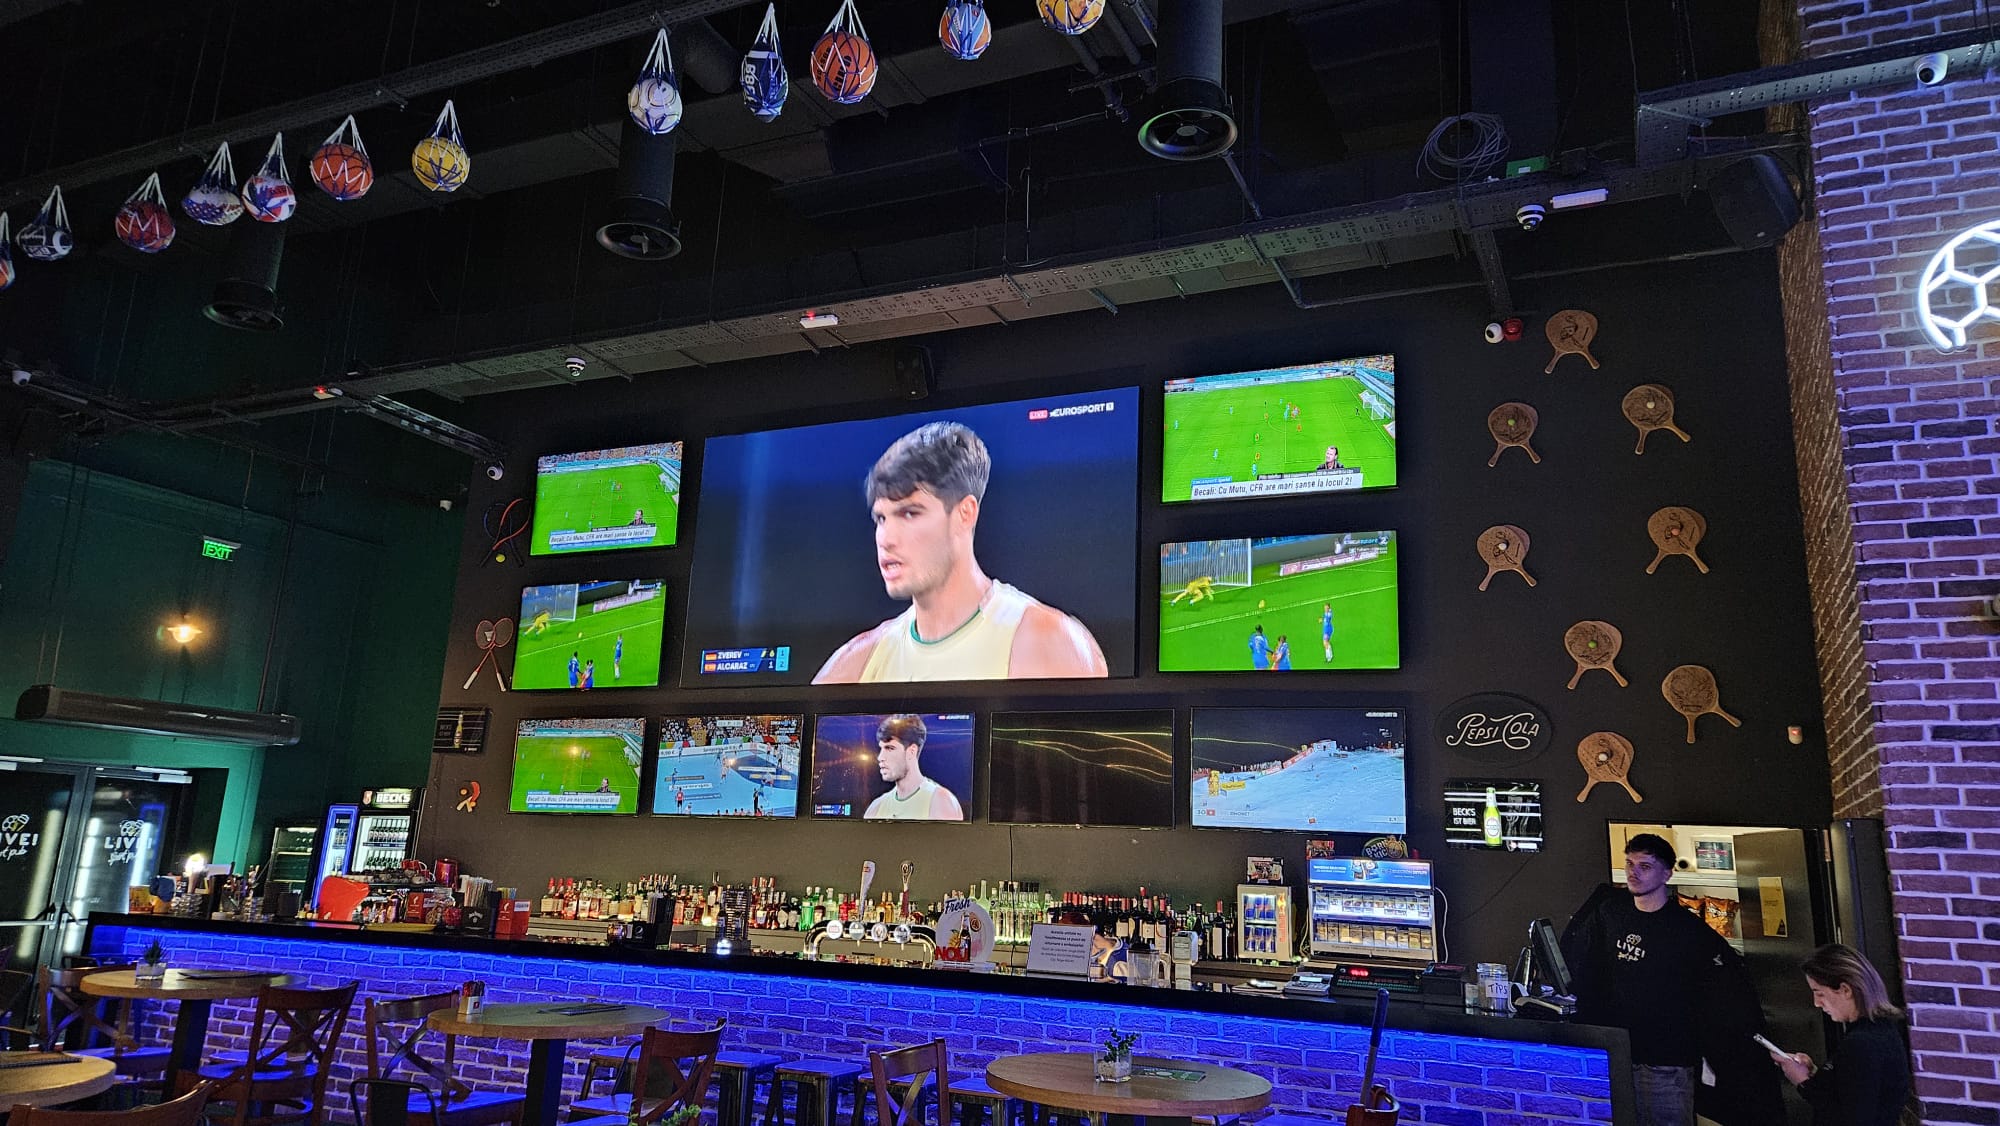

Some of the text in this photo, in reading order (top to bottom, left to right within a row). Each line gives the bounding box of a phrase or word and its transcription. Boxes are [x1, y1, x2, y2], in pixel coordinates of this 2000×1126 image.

[1194, 487, 1216, 496] Becali:
[1218, 486, 1226, 495] Cu
[1229, 485, 1247, 494] Mutu,
[1249, 483, 1263, 492] CFR
[1278, 480, 1293, 490] mari
[1317, 478, 1324, 487] la
[1326, 477, 1343, 487] locul
[1345, 476, 1352, 485] 2!
[206, 544, 233, 559] EXIT
[718, 651, 742, 659] ZVEREV
[717, 662, 748, 670] ALCARAZ
[1446, 713, 1540, 750] PEPSI COLA
[1452, 807, 1476, 816] BECK'S
[1453, 817, 1462, 825] IST
[0, 832, 39, 847] IVE!
[945, 899, 970, 914] Fresh
[935, 946, 970, 962] NOU
[1616, 939, 1646, 958] LIVE!
